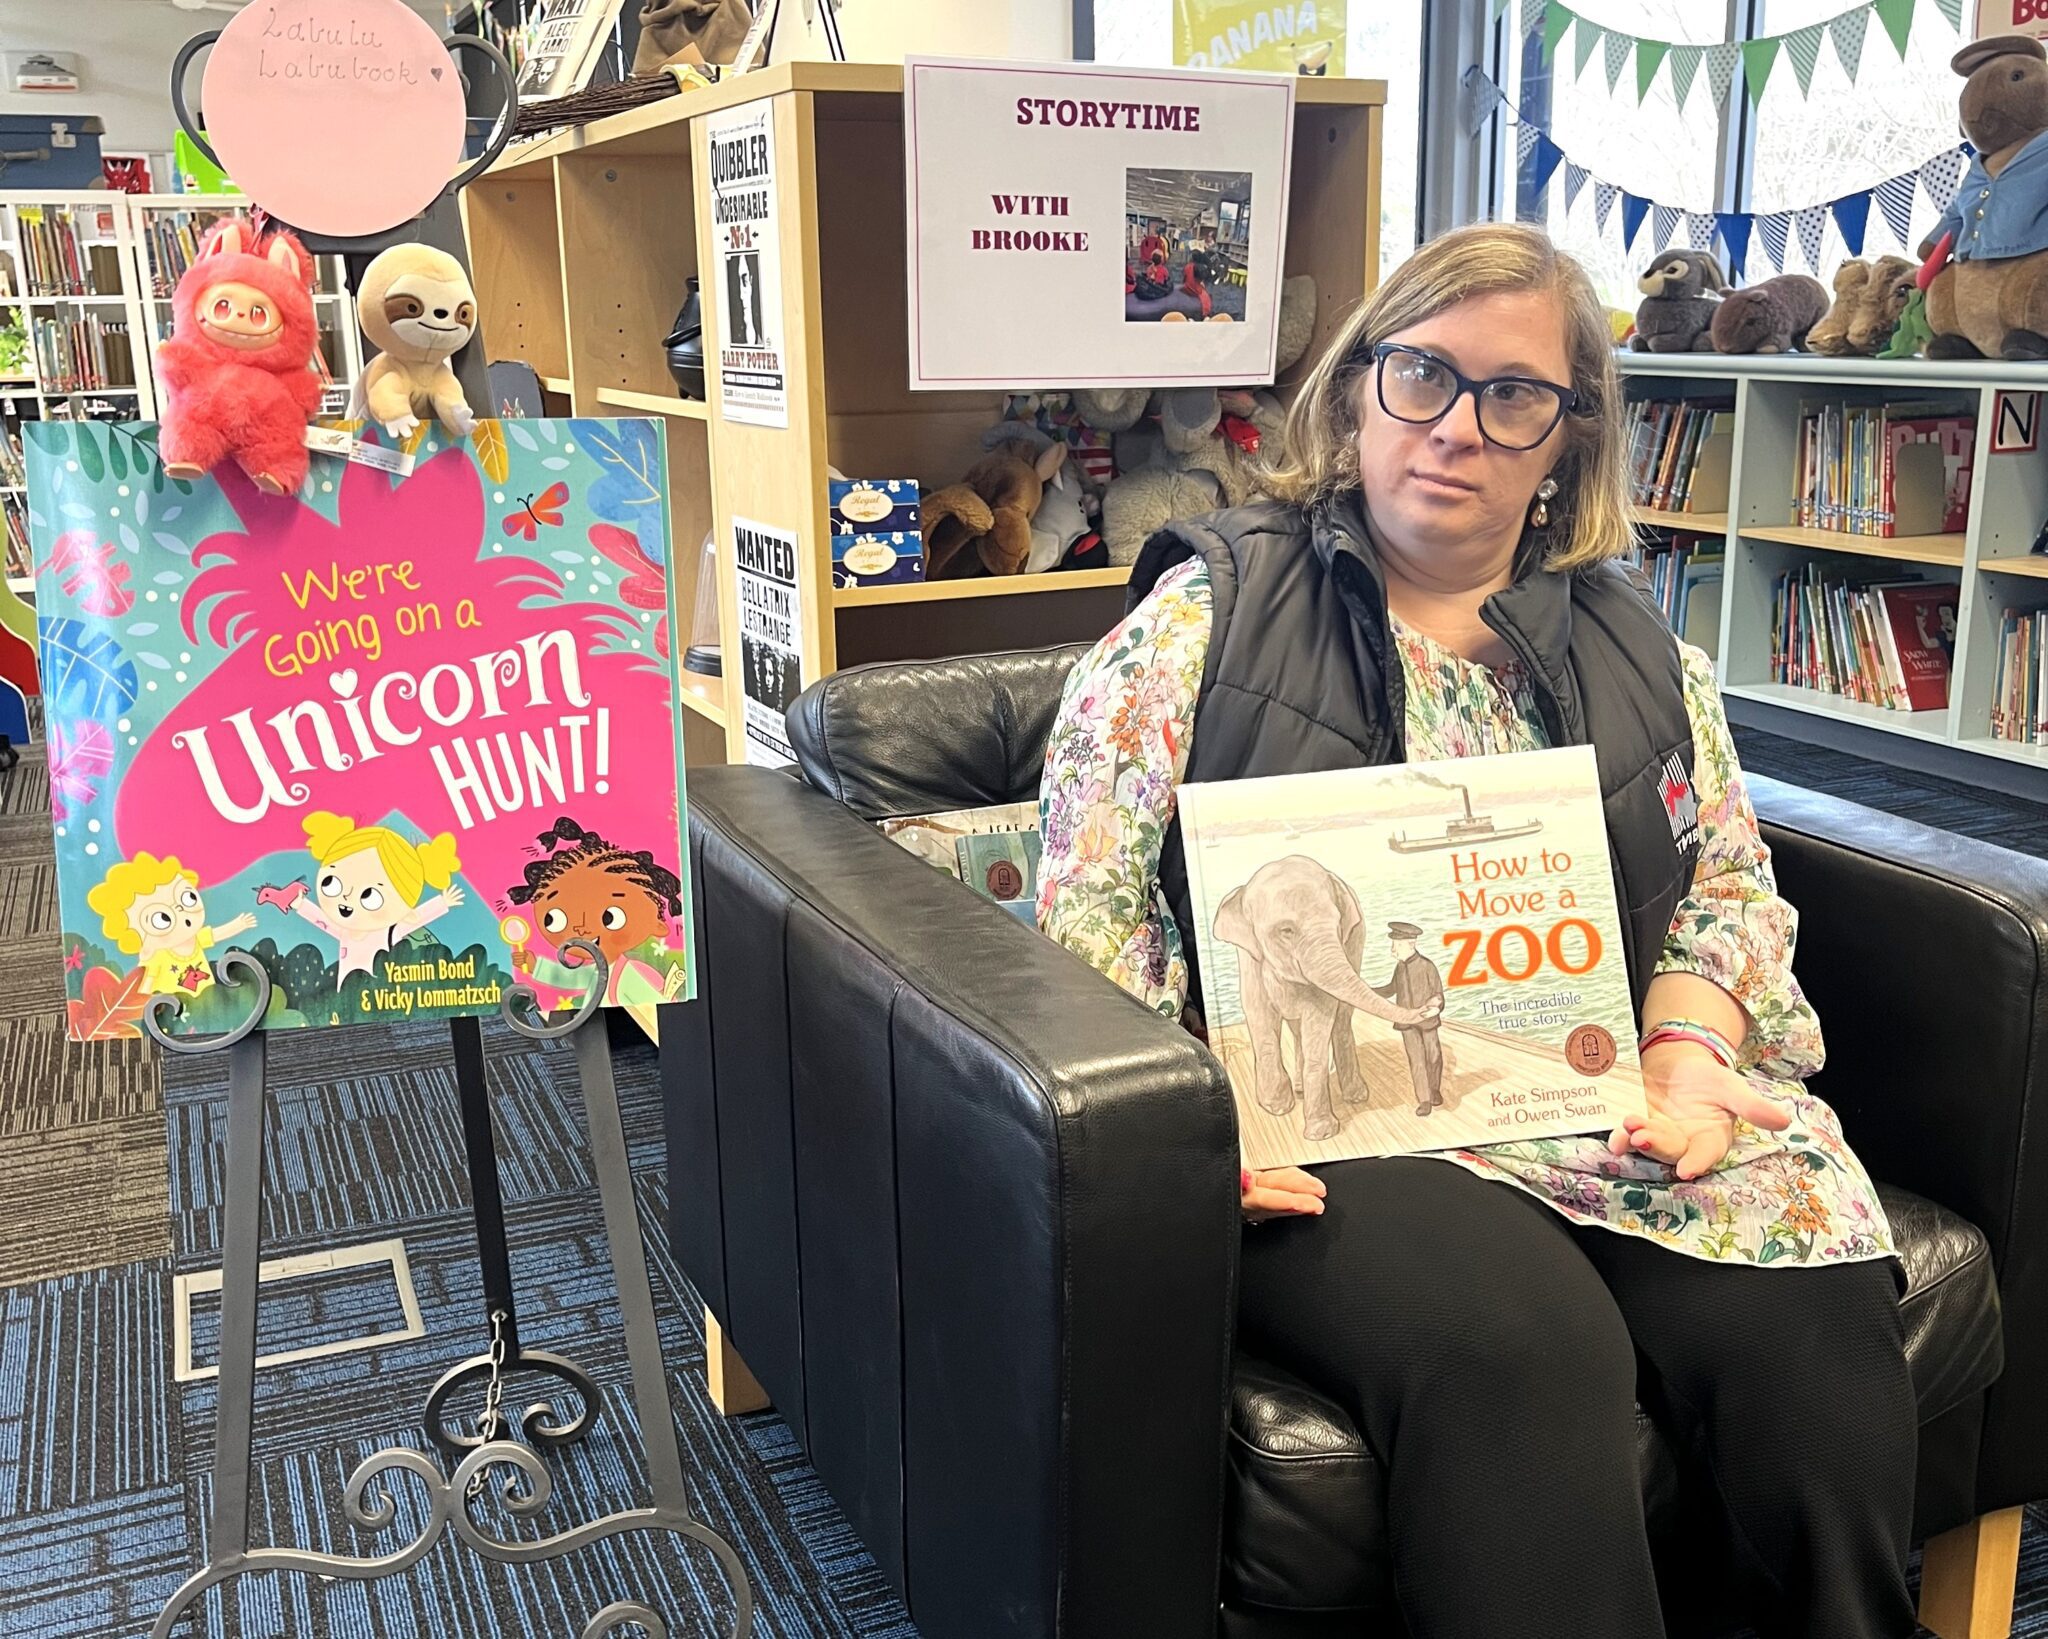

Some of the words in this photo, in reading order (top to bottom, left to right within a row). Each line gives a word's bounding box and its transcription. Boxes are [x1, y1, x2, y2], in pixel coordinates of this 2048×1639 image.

[537, 38, 573, 54] CARRO
[544, 22, 582, 38] ALECT
[1017, 97, 1200, 132] STORYTIME
[710, 134, 769, 194] QUIBBLER
[715, 190, 768, 225] UNDESIRABLE
[991, 194, 1070, 216] WITH
[971, 229, 1089, 252] BROOKE
[747, 352, 779, 370] POTTER
[1998, 393, 2035, 445] N
[850, 495, 881, 506] Regal
[735, 526, 795, 580] WANTED
[854, 547, 884, 560] Regal
[281, 560, 422, 609] We're
[742, 576, 791, 619] BELLATRIX
[264, 612, 382, 677] Going
[395, 602, 441, 636] on
[455, 599, 482, 629] a
[743, 605, 792, 647] LESTRANGE
[172, 629, 591, 824] Unicorn
[429, 706, 610, 830] HUNT!
[1450, 851, 1528, 884] How
[1540, 847, 1572, 873] to
[1456, 888, 1546, 920] Move
[1558, 889, 1578, 909] a
[384, 960, 435, 983] Yasmin
[438, 954, 475, 980] Bond
[1442, 917, 1604, 988] ZOO
[361, 989, 372, 1012] &
[374, 985, 414, 1015] Vicky
[417, 979, 501, 1009] Lommatzsch
[1478, 999, 1509, 1015] The
[1513, 991, 1582, 1012] incredible
[1498, 1016, 1528, 1030] true
[1532, 1012, 1569, 1027] story
[1490, 1091, 1527, 1108] Kate
[1530, 1085, 1598, 1102] Simpson
[1487, 1113, 1511, 1128] and
[1515, 1107, 1560, 1124] Owen
[1564, 1102, 1607, 1118] Swan
